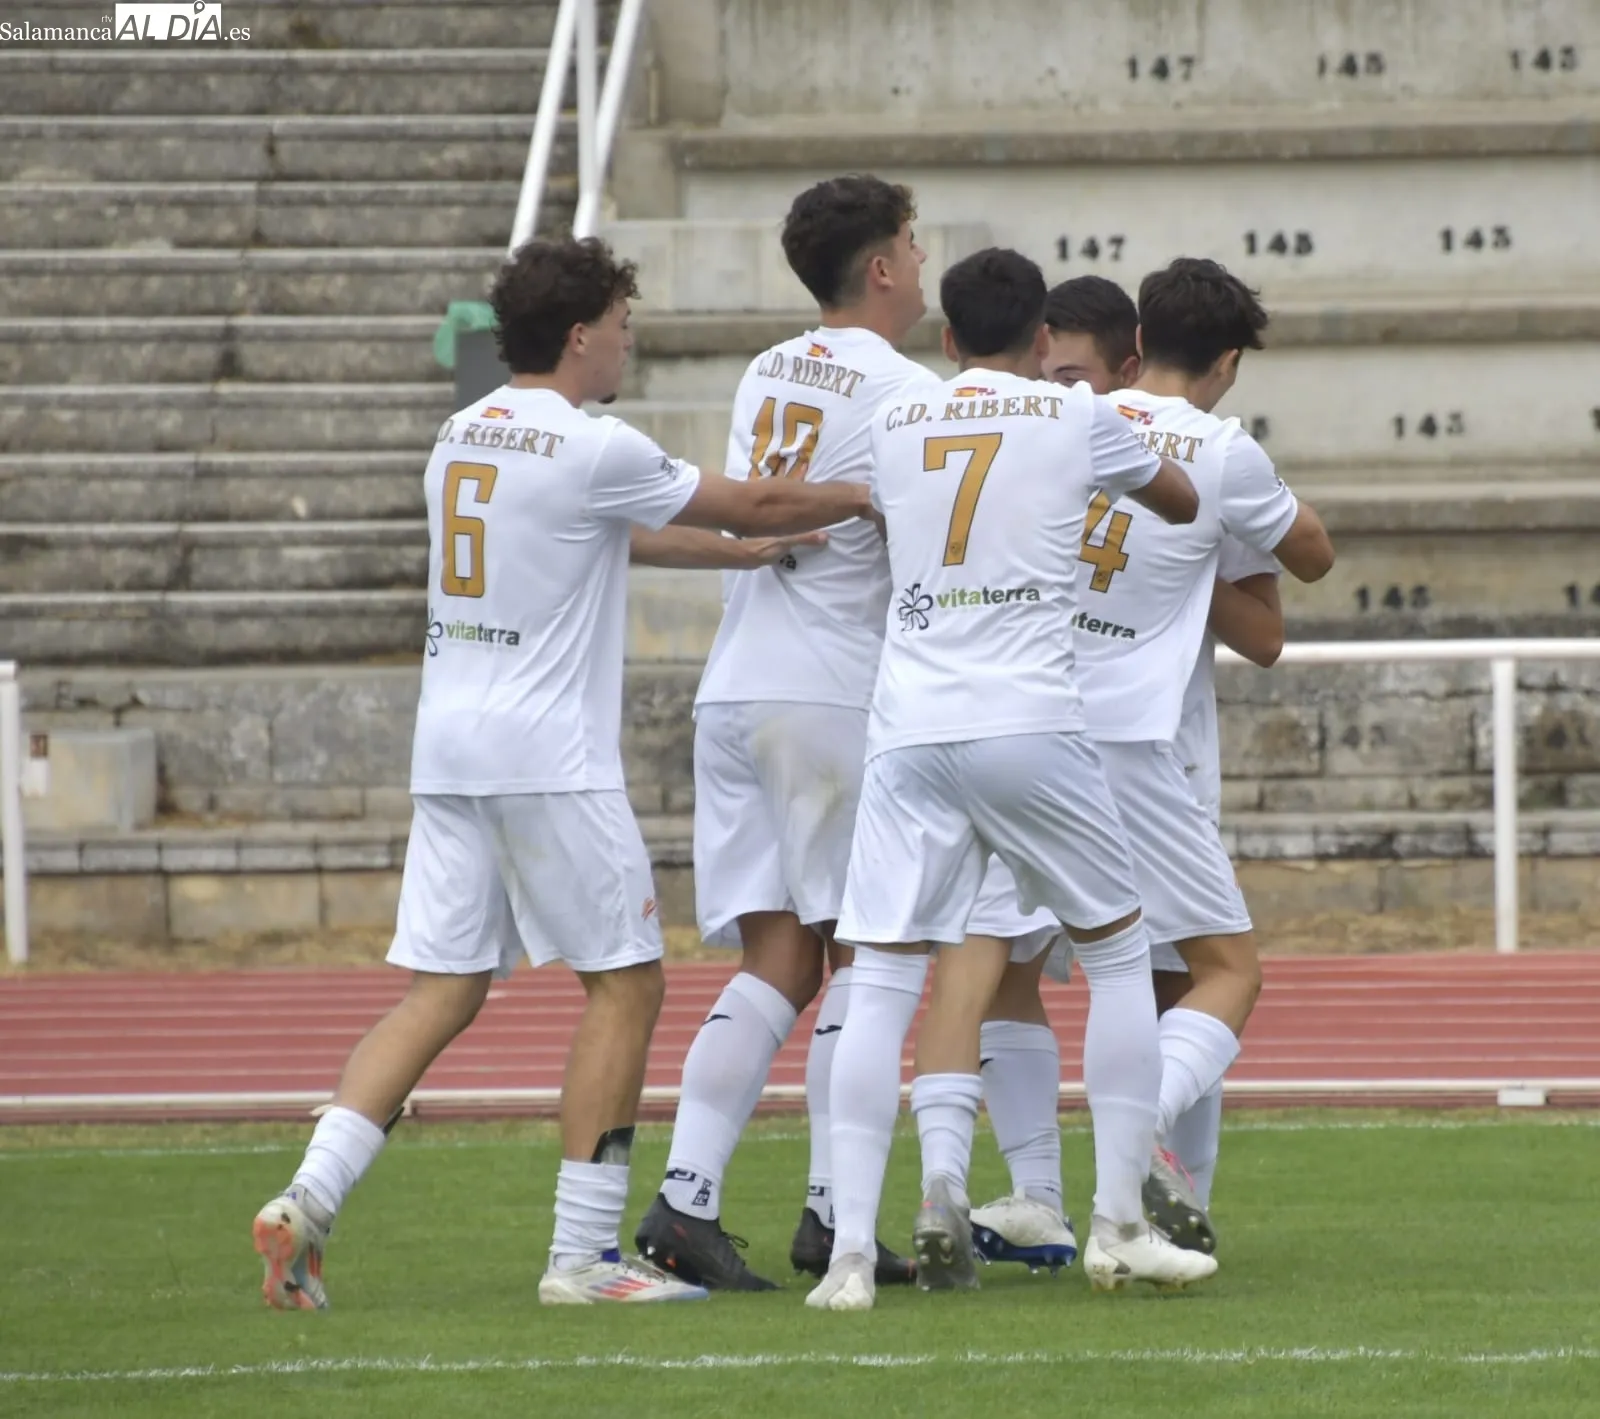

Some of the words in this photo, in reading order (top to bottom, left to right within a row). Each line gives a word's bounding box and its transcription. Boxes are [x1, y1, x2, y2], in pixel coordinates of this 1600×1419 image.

[1125, 53, 1196, 82] 147
[1055, 234, 1126, 262] 147
[787, 356, 866, 399] RIBERT
[886, 403, 932, 432] C.D.
[940, 395, 1063, 421] RIBERT
[459, 422, 565, 458] RIBERT
[922, 432, 1003, 567] 7
[441, 460, 498, 598] 6
[1078, 487, 1133, 593] 4
[936, 584, 1041, 609] vitaterra
